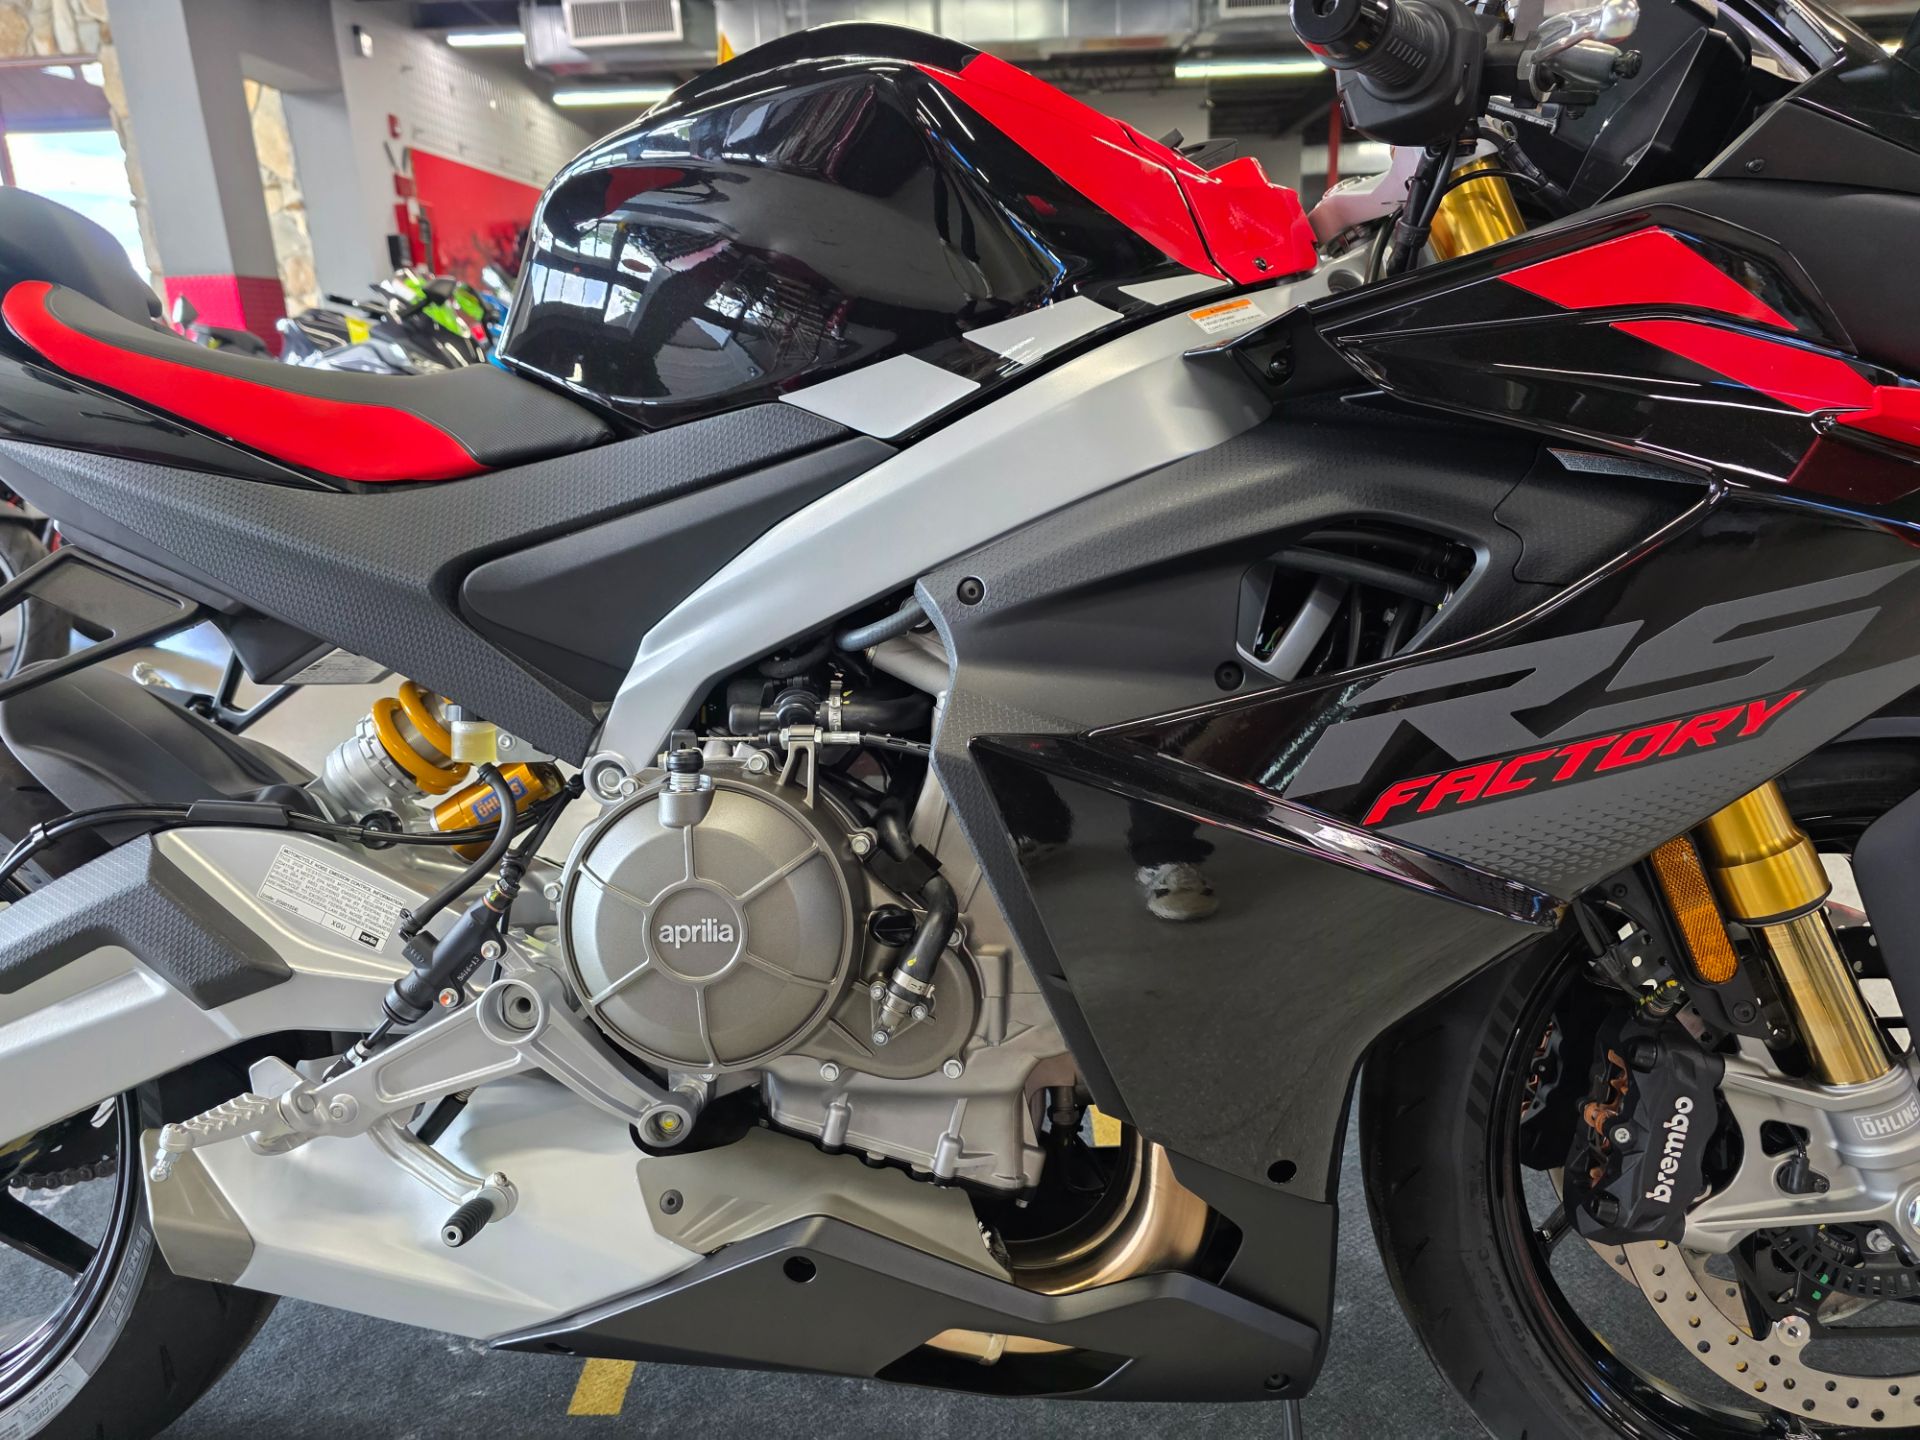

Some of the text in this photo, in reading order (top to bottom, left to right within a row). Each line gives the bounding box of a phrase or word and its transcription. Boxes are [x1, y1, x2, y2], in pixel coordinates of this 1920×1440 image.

[1283, 559, 1920, 799] RS
[1362, 690, 1806, 826] FACTORY
[282, 848, 314, 865] MOTORCYCLE
[313, 862, 328, 872] NOISE
[328, 869, 350, 882] EMISSION
[350, 879, 372, 892] CONTROL
[372, 889, 403, 906] INFORMATION
[330, 919, 347, 931] XGU
[659, 918, 734, 949] aprilia
[1860, 1101, 1919, 1136] ÖHLINS
[1646, 1096, 1694, 1203] brembo
